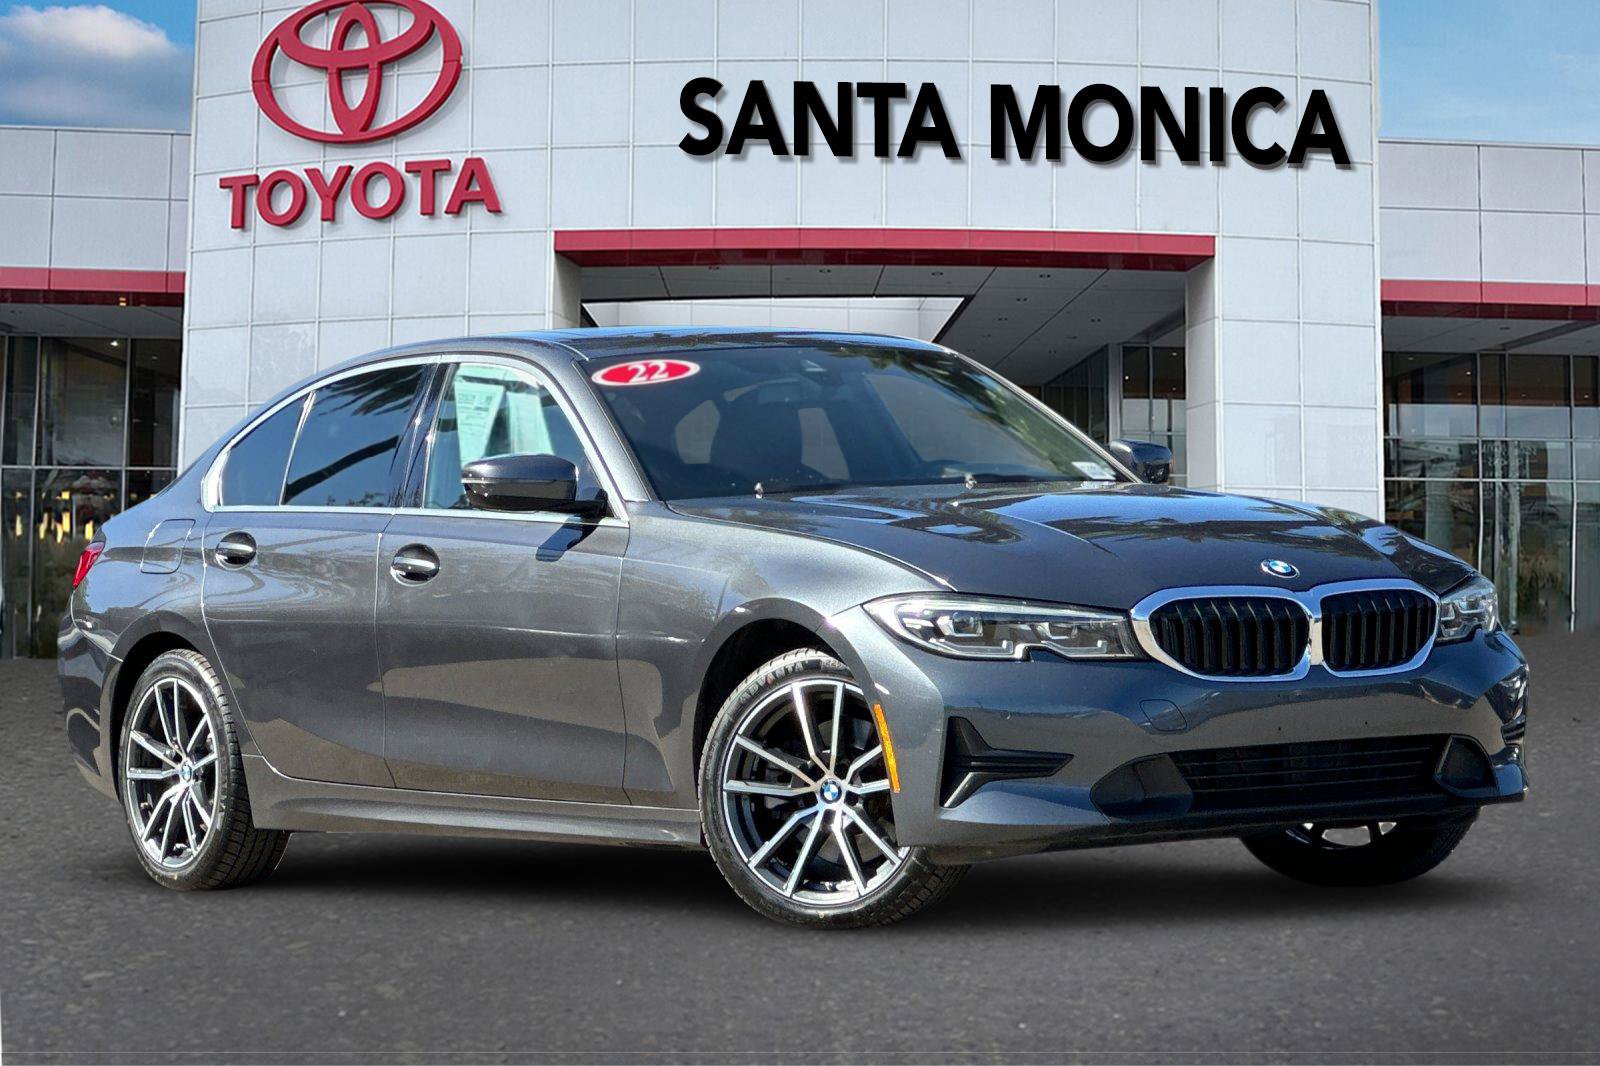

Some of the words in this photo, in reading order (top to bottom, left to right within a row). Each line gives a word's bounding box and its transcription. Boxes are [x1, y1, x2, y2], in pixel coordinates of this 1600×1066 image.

[678, 77, 962, 160] SANTA
[990, 83, 1351, 166] MONICA
[219, 157, 502, 229] TOYOTA
[627, 361, 669, 383] 22
